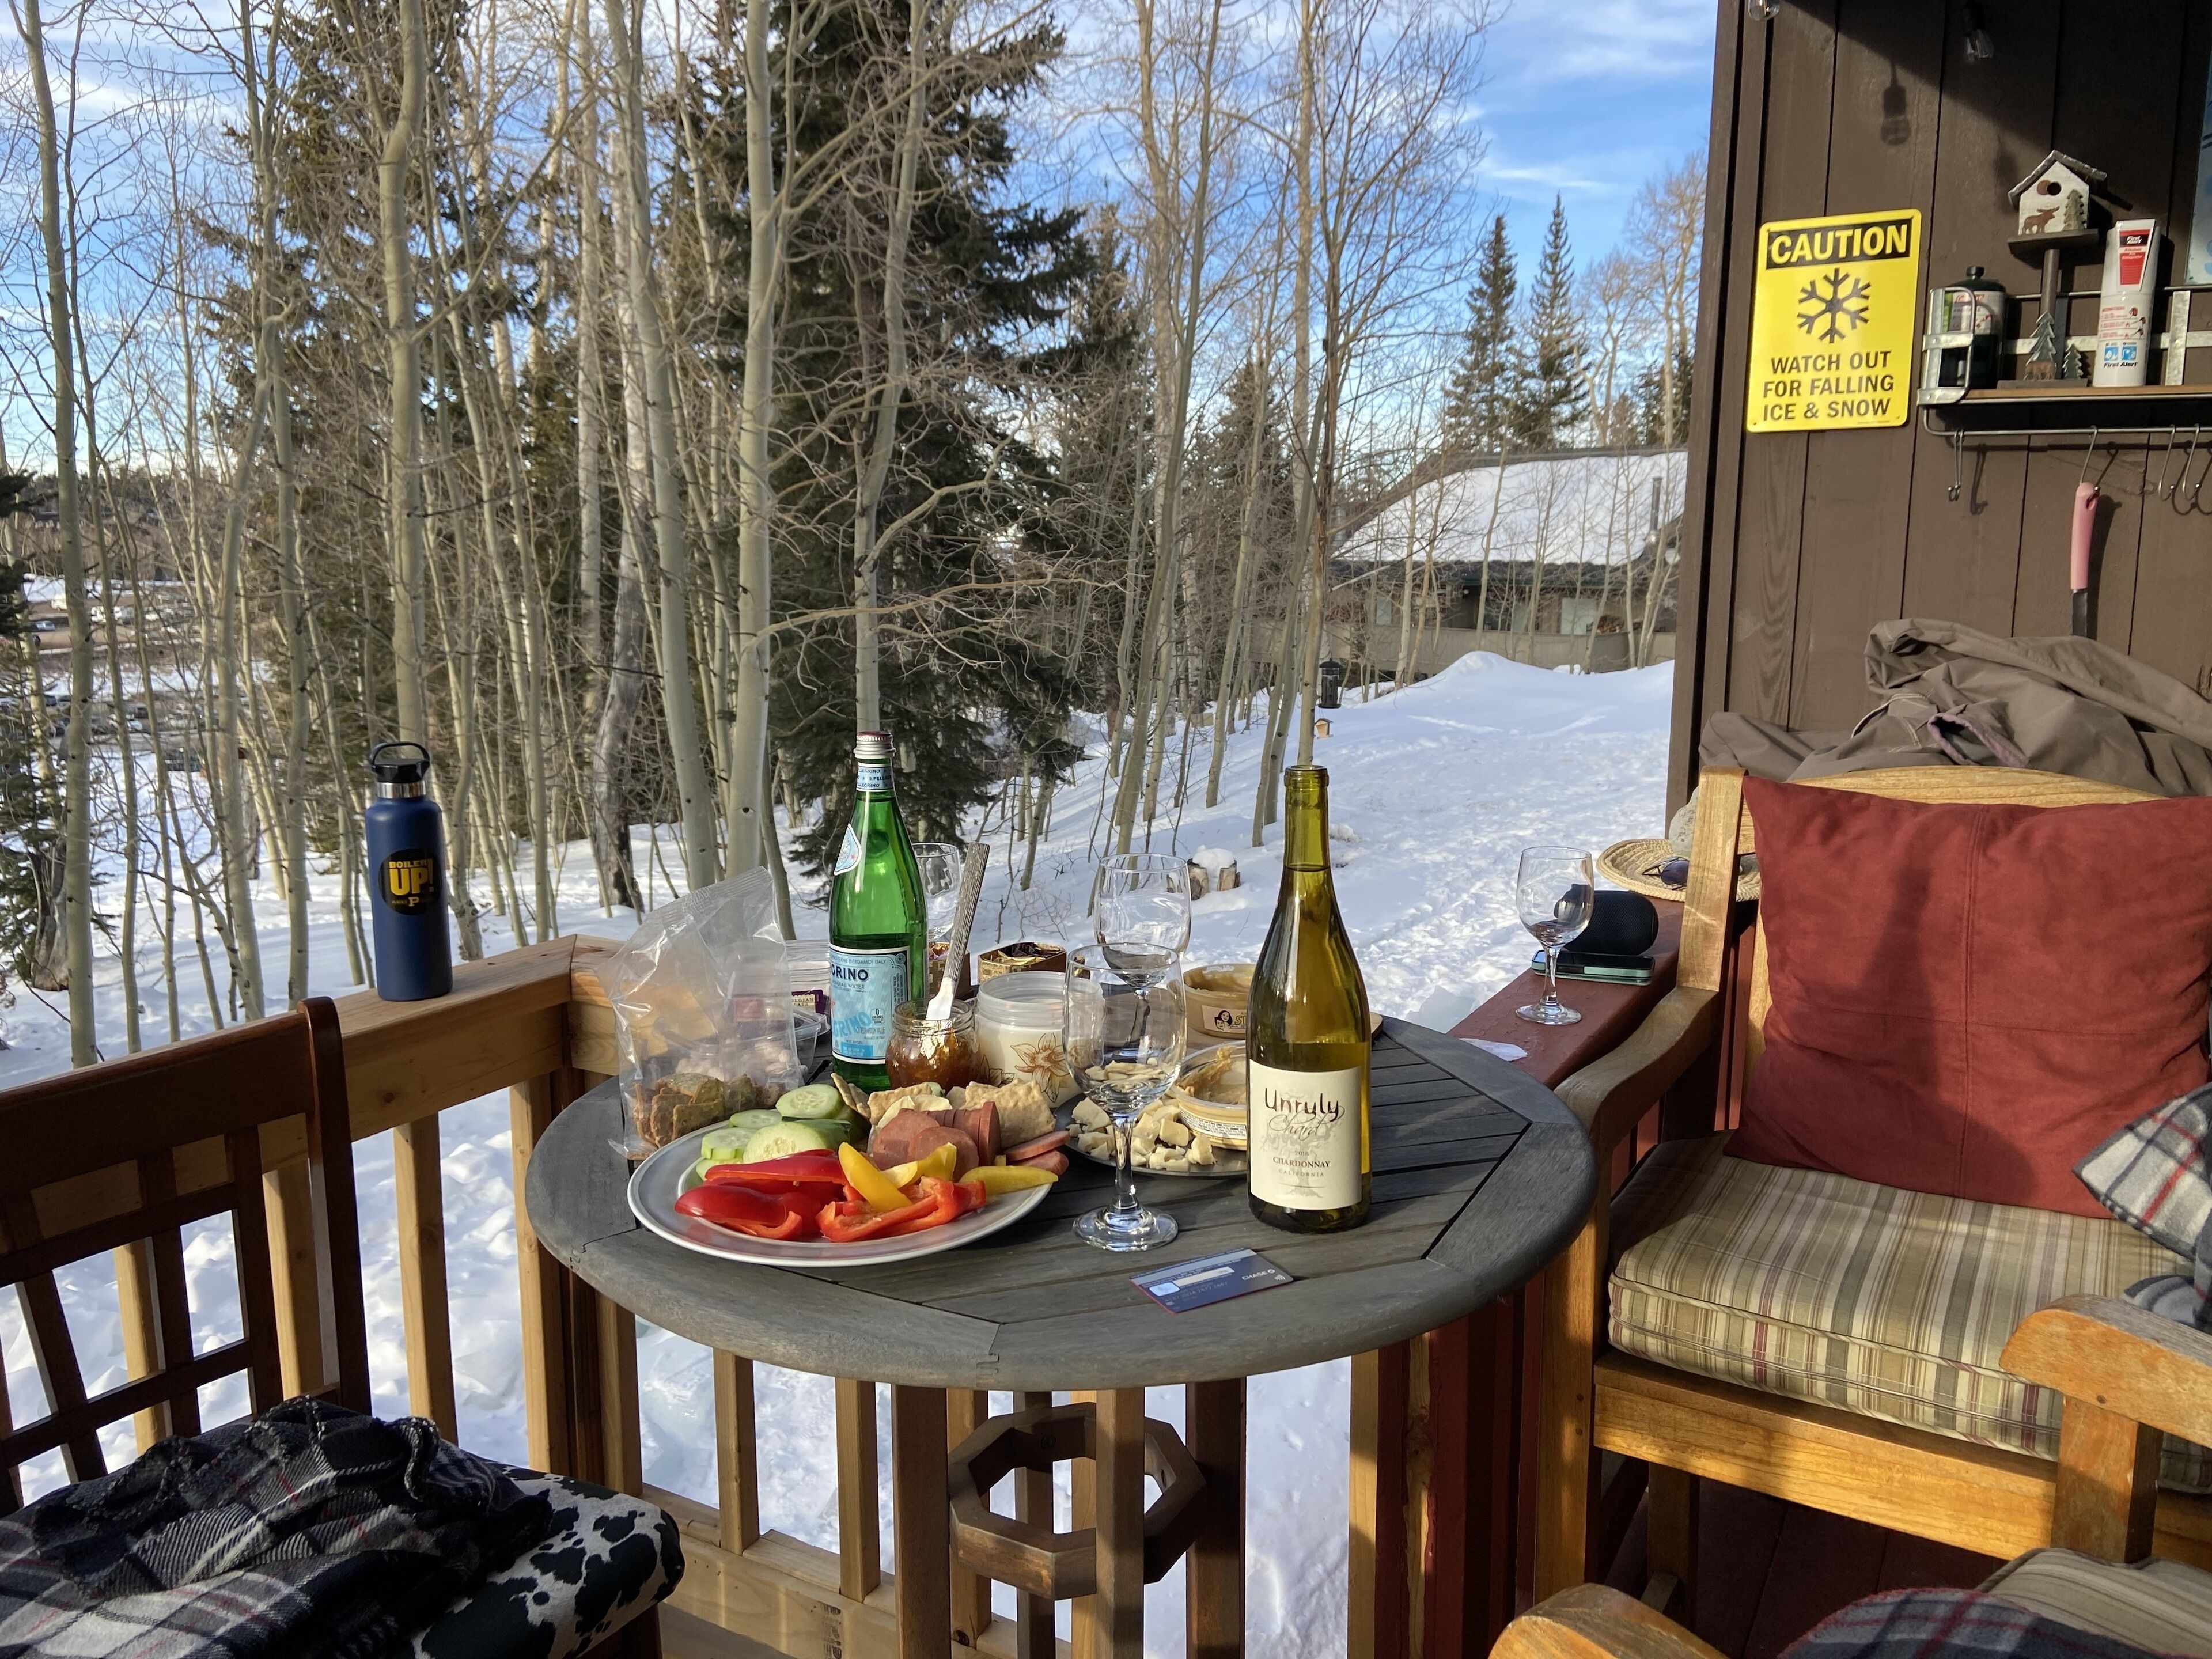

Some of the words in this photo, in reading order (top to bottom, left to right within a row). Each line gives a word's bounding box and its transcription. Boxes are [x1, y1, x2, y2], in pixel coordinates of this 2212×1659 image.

[1771, 224, 1908, 265] CAUTION
[1771, 353, 1842, 374] WATCH
[1850, 350, 1892, 370] OUT
[1763, 379, 1802, 399] FOR
[1809, 374, 1895, 396] FALLING
[1763, 403, 1797, 421] ICE
[1804, 402, 1820, 419] &
[1827, 397, 1891, 418] SNOW
[389, 859, 427, 868] BOILER
[389, 859, 434, 896] UP!
[408, 896, 420, 907] P
[1264, 1087, 1339, 1122] Unruly
[1268, 1105, 1345, 1142] Chard
[1272, 1156, 1331, 1168] CHARDONNAY
[1278, 1169, 1324, 1177] CALIFORNIA
[1241, 1271, 1268, 1281] CHASE
